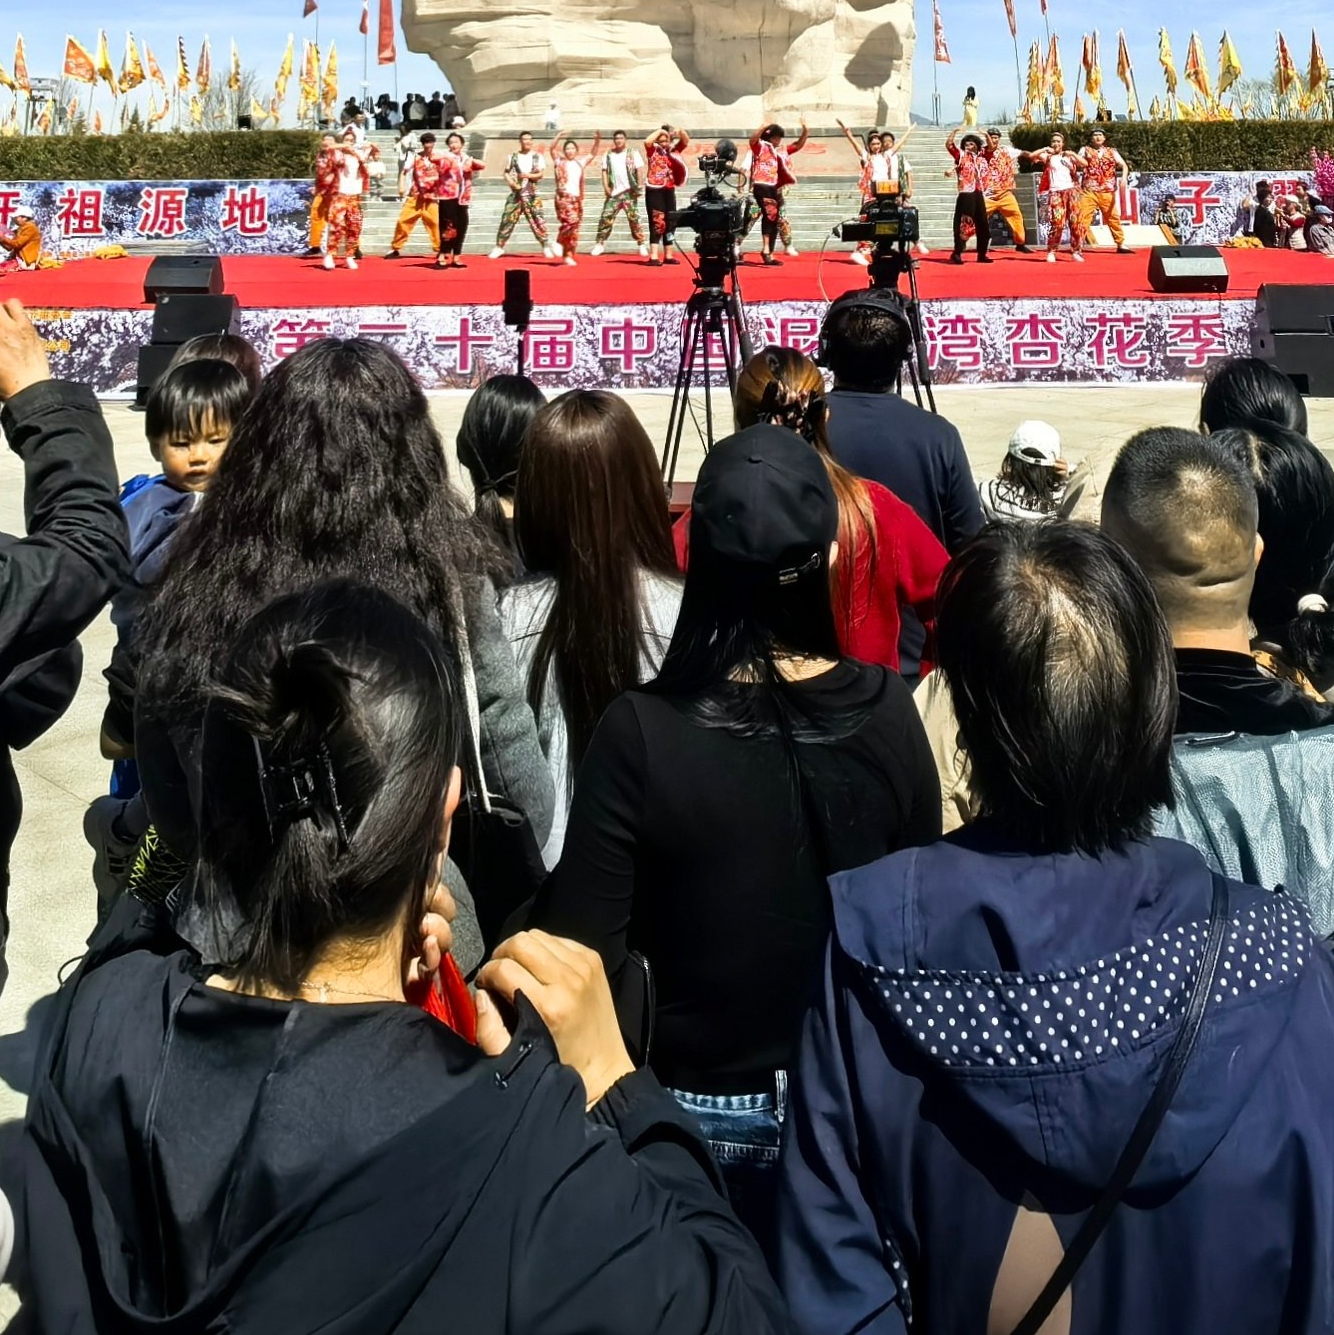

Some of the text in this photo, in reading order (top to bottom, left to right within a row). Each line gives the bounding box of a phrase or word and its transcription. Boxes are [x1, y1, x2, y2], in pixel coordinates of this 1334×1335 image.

[271, 312, 1230, 374] 第二十届中国泥湾杏花季
